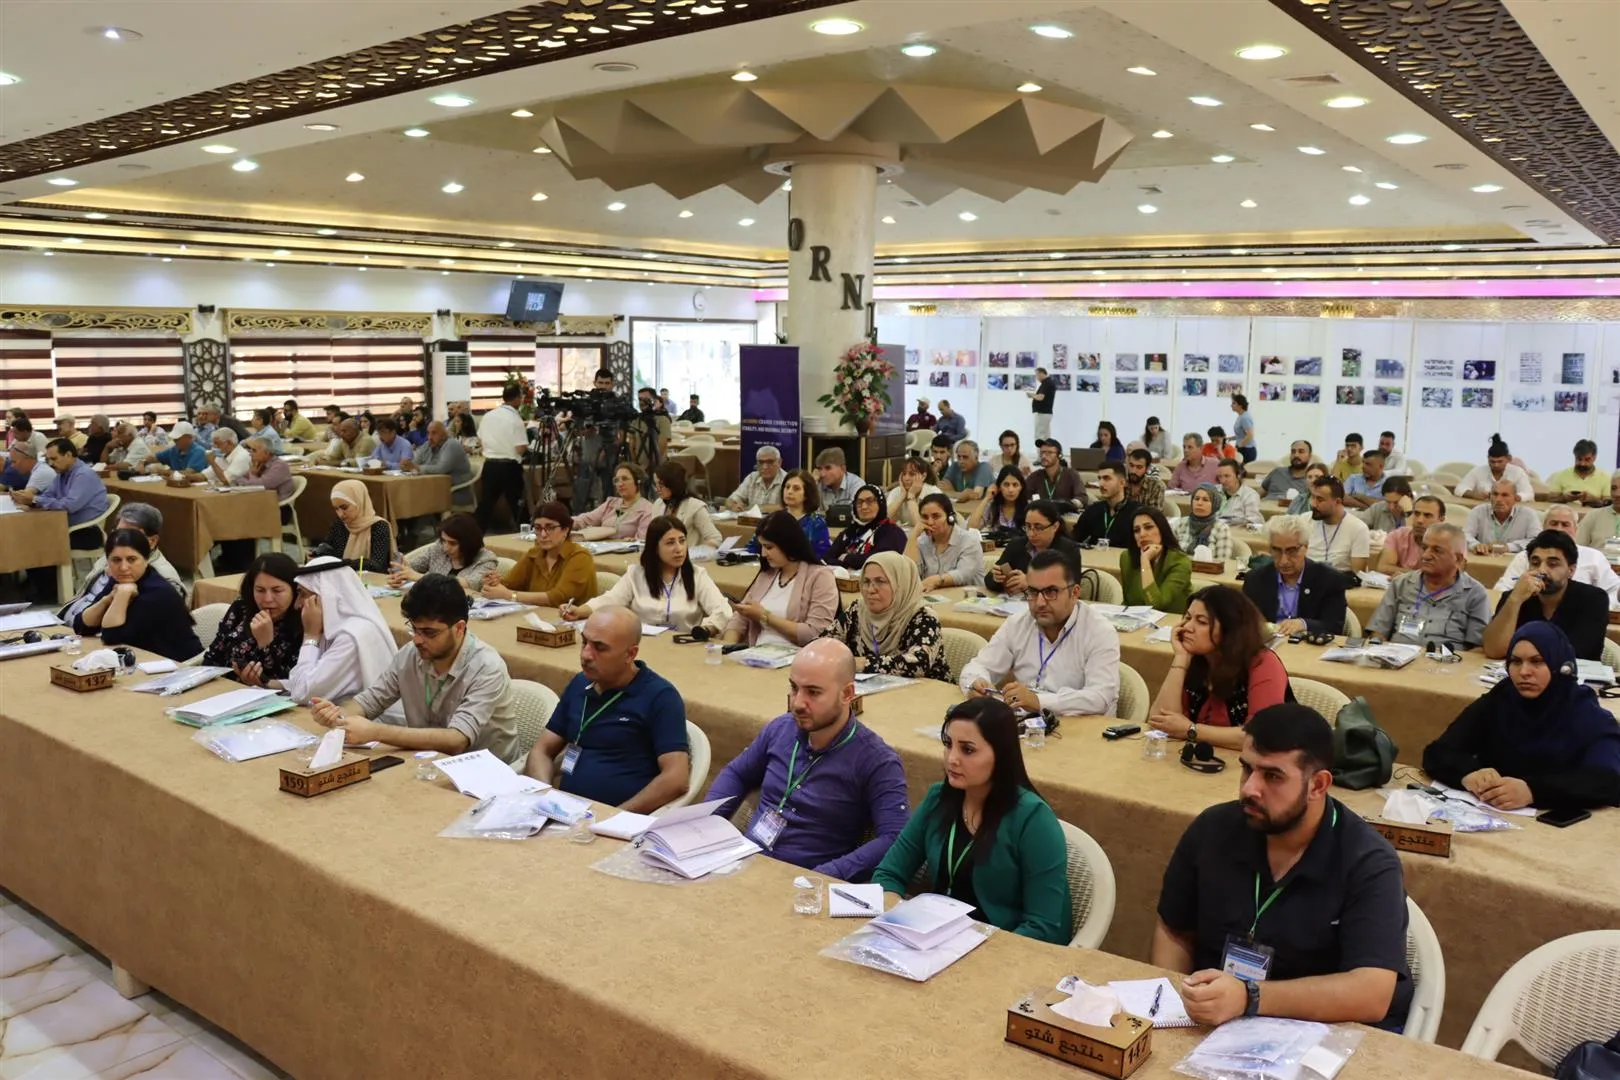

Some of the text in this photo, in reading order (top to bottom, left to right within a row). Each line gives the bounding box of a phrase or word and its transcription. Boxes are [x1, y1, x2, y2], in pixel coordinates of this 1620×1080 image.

[86, 675, 106, 687] 137
[283, 775, 304, 789] 159
[337, 767, 361, 783] منتجع
[1024, 1027, 1104, 1062] منتجع شتو
[1128, 1035, 1148, 1064] 147
